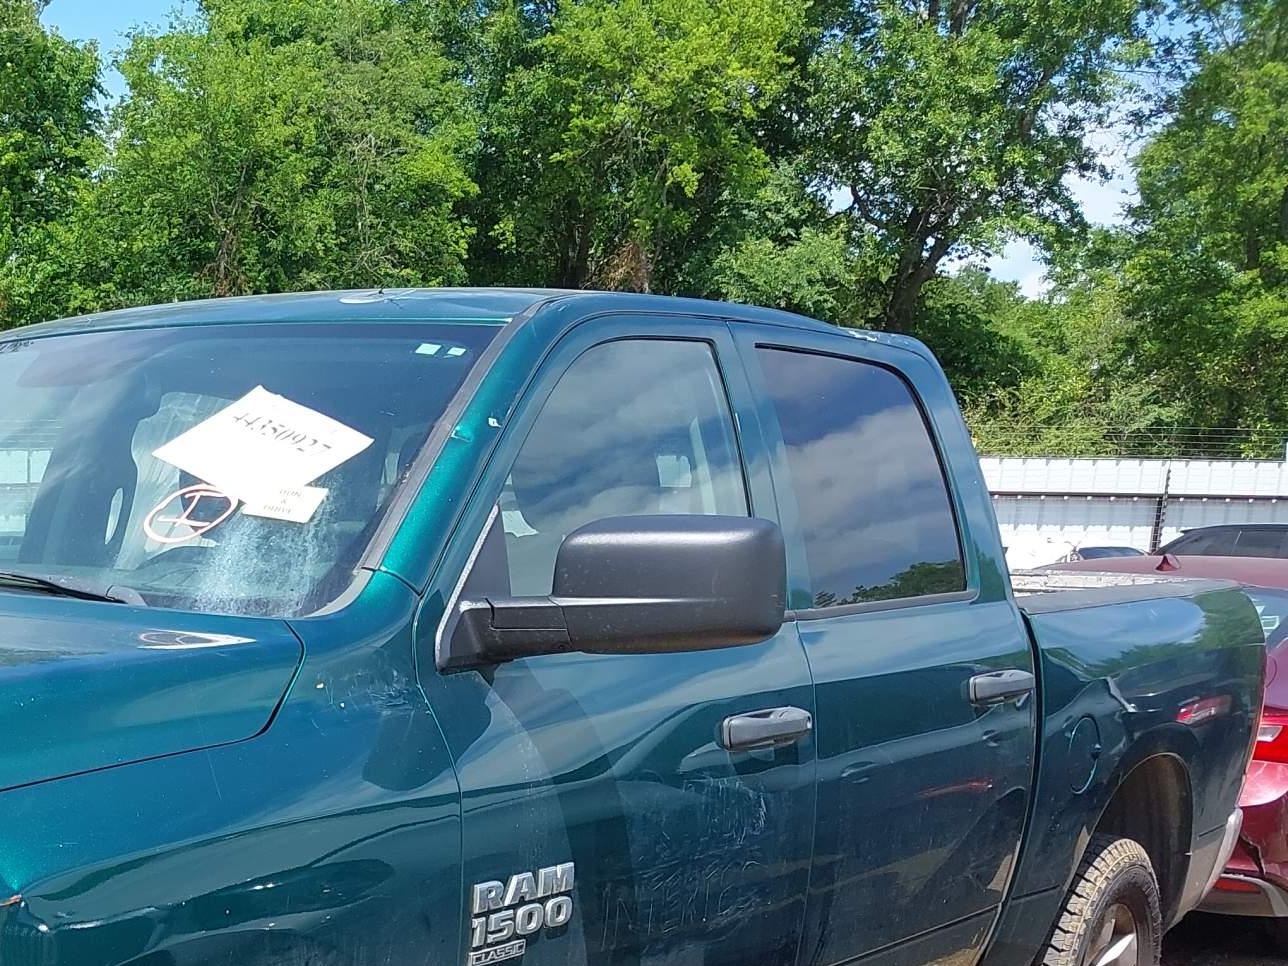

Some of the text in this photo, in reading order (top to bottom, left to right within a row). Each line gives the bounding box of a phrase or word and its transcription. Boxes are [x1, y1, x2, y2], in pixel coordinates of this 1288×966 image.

[473, 862, 575, 915] RAM
[471, 896, 574, 948] 1500
[471, 941, 525, 966] CLASSIC
